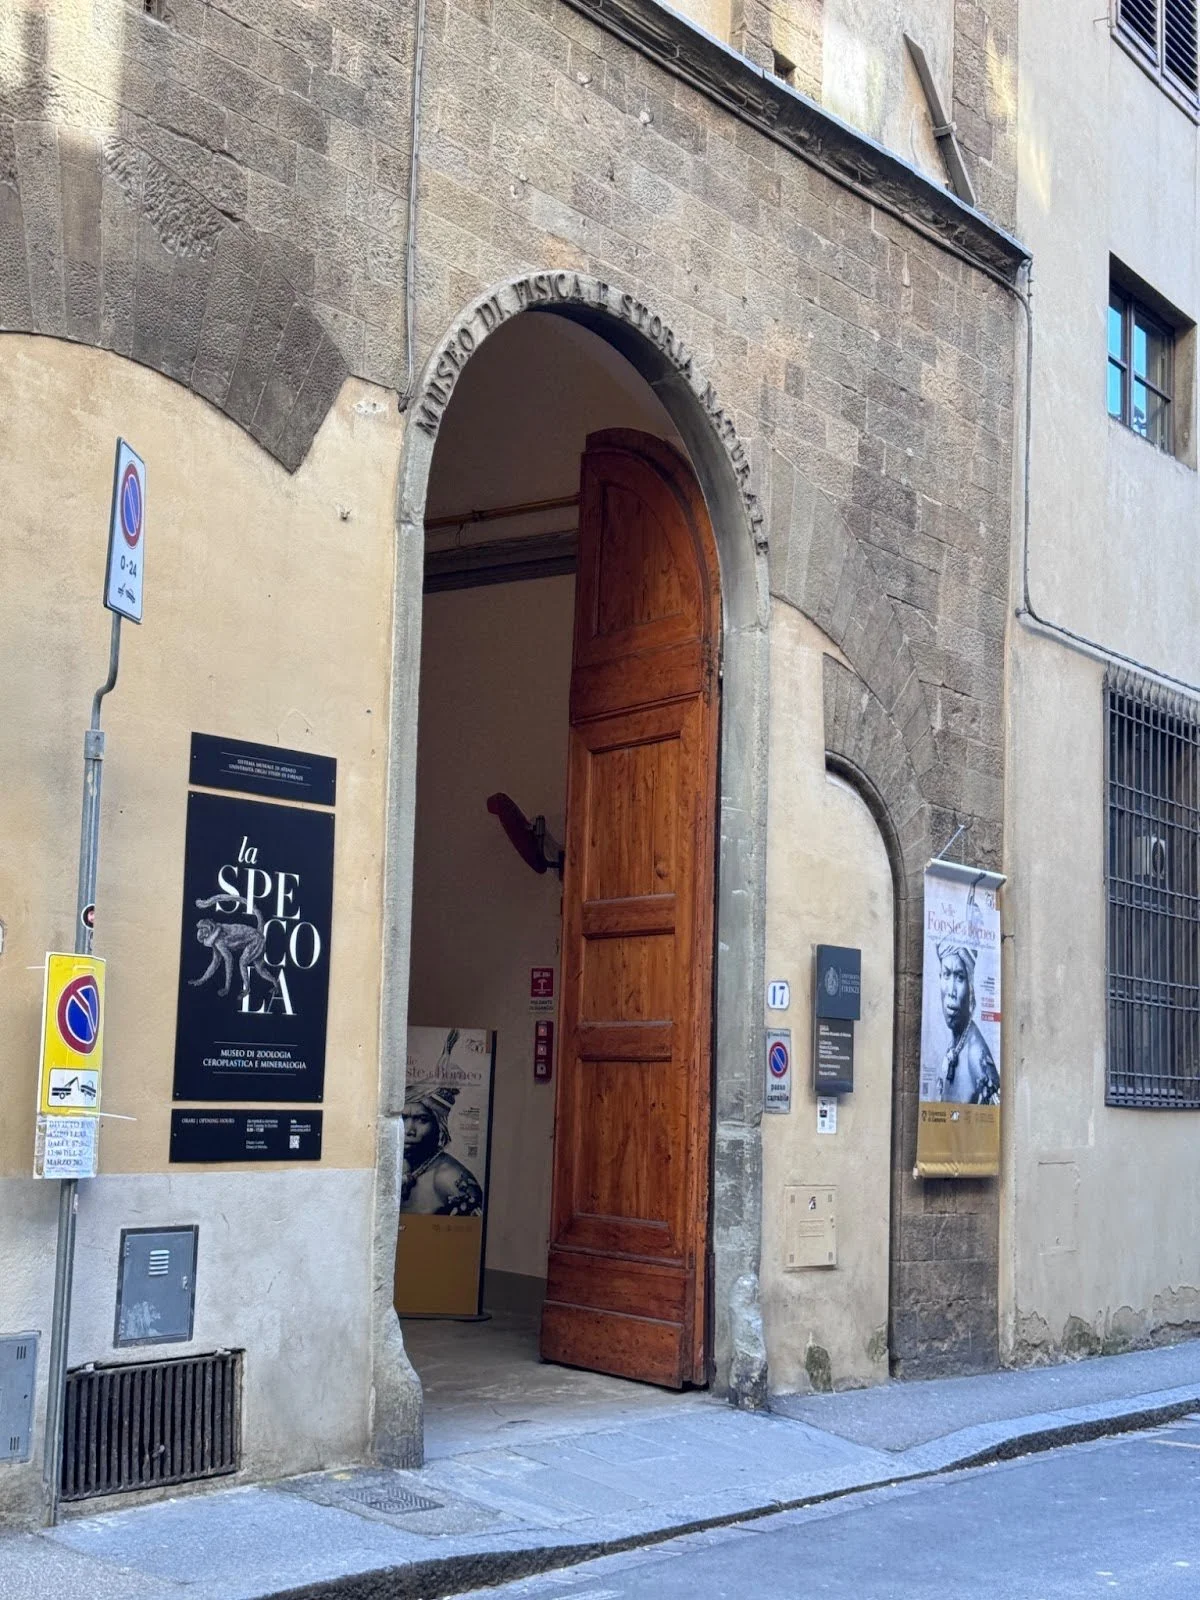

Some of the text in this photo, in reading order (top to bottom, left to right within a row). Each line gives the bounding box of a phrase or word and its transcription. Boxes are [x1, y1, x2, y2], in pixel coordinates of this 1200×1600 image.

[416, 327, 475, 438] MUSEO
[512, 272, 583, 306] FISICA
[621, 294, 694, 380] STORIA
[700, 381, 769, 557] NATURALE
[238, 835, 258, 864] la
[772, 985, 785, 1006] 17
[203, 1058, 307, 1070] CEROPLASTICA E MINERALOGIA
[220, 1049, 291, 1059] MUSEO DI ZOOLOGIA
